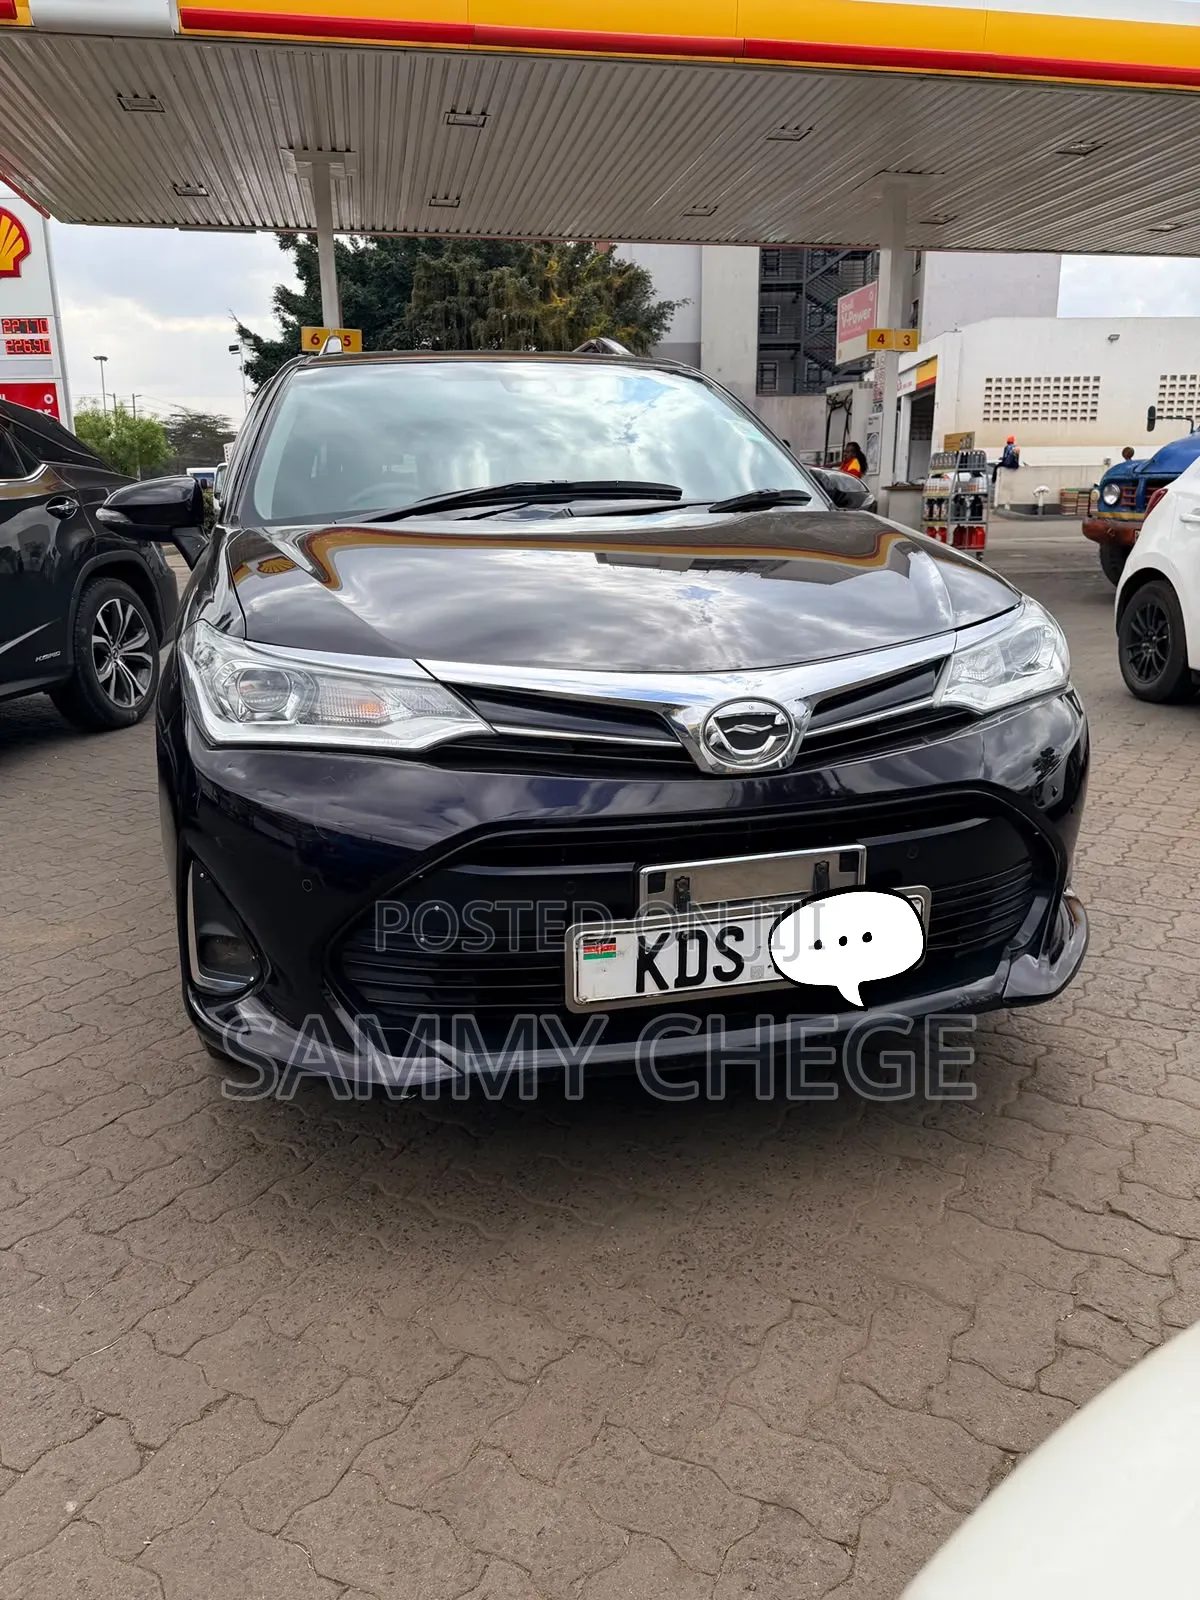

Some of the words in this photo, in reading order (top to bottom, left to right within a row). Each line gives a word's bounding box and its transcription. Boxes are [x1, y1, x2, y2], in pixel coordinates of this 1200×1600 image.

[841, 307, 872, 329] V-Power
[2, 319, 49, 334] 227.70
[310, 333, 320, 345] 6
[343, 335, 351, 347] 5
[877, 333, 885, 345] 4
[903, 335, 911, 346] 3
[5, 339, 51, 353] 226.90
[636, 925, 745, 993] KDS
